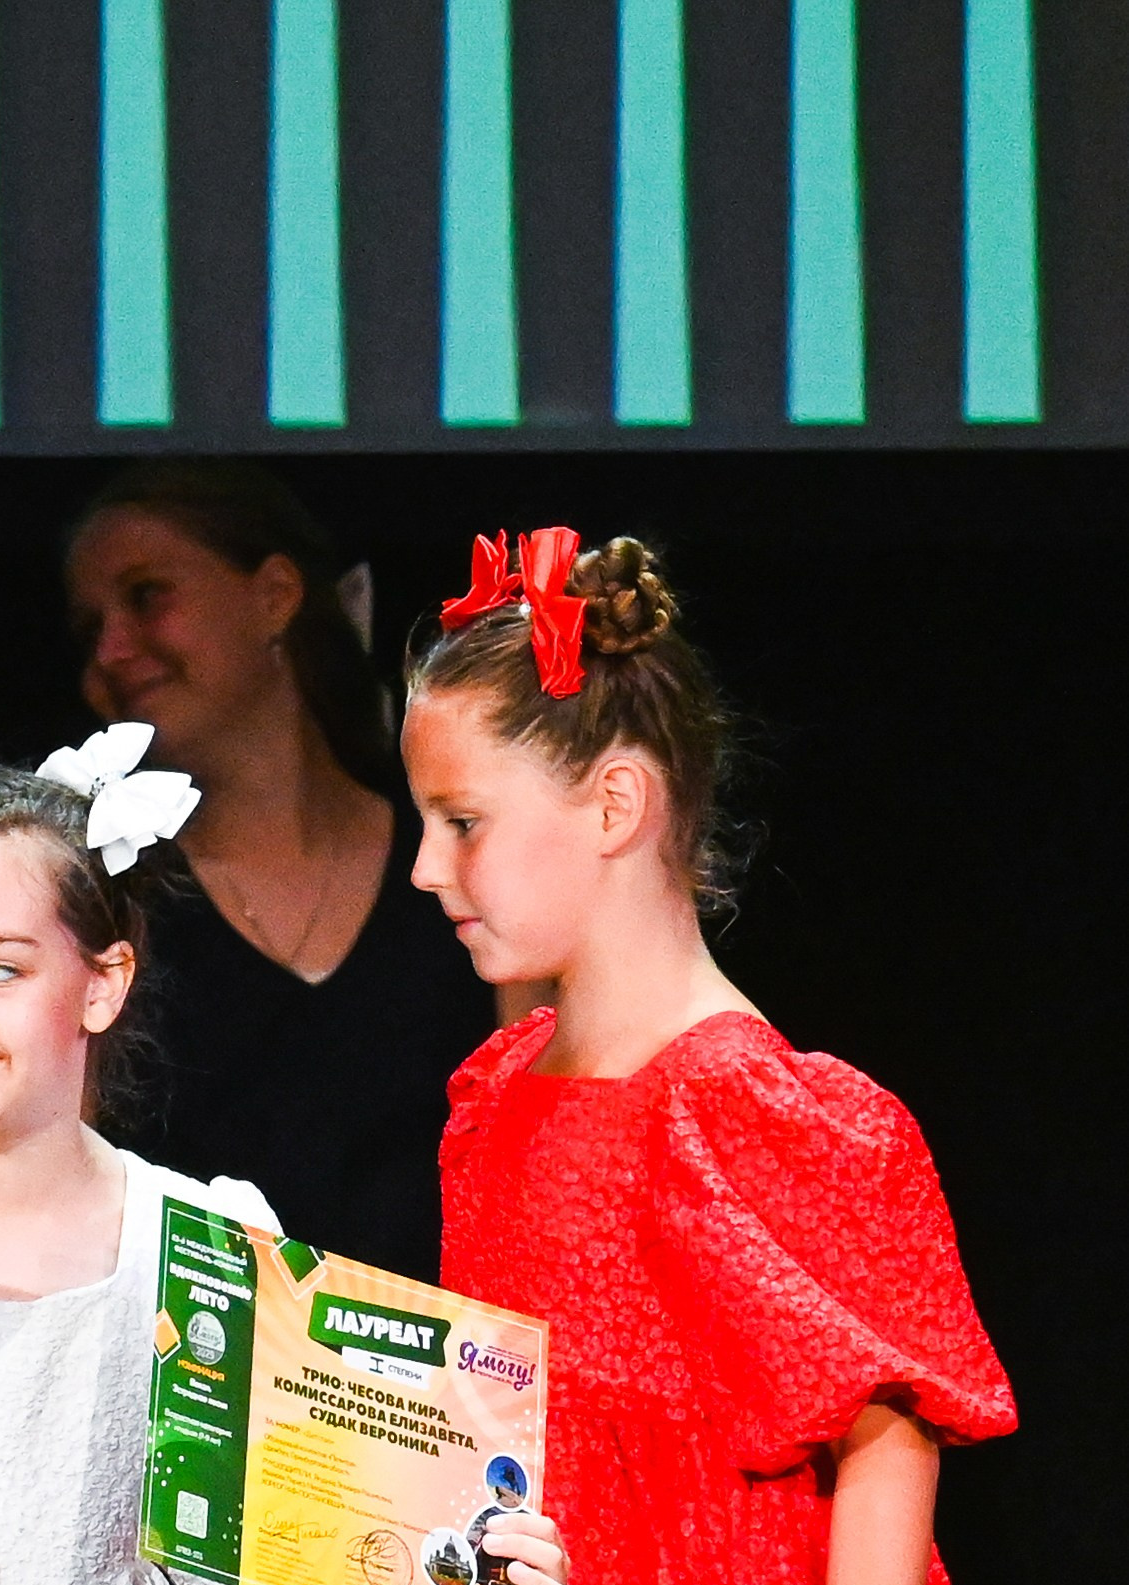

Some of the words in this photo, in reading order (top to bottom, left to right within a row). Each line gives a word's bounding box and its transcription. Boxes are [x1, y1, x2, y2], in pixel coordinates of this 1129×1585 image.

[188, 1284, 230, 1312] ЛЕТО
[324, 1306, 435, 1350] ЛАУРЕАТ
[369, 1356, 384, 1374] I
[388, 1364, 422, 1381] СТЕПЕНИ
[458, 1340, 479, 1373] Я
[477, 1355, 537, 1392] могу!
[274, 1376, 387, 1424] КОМИССАРОВА
[389, 1413, 479, 1452] ЕЛИЗАВЕТА,
[301, 1366, 345, 1392] ТРИО:
[347, 1381, 406, 1411] ЧЕСОВА
[407, 1400, 451, 1426] КИРА,
[309, 1406, 357, 1433] СУДАК
[359, 1424, 441, 1458] ВЕРОНИКА
